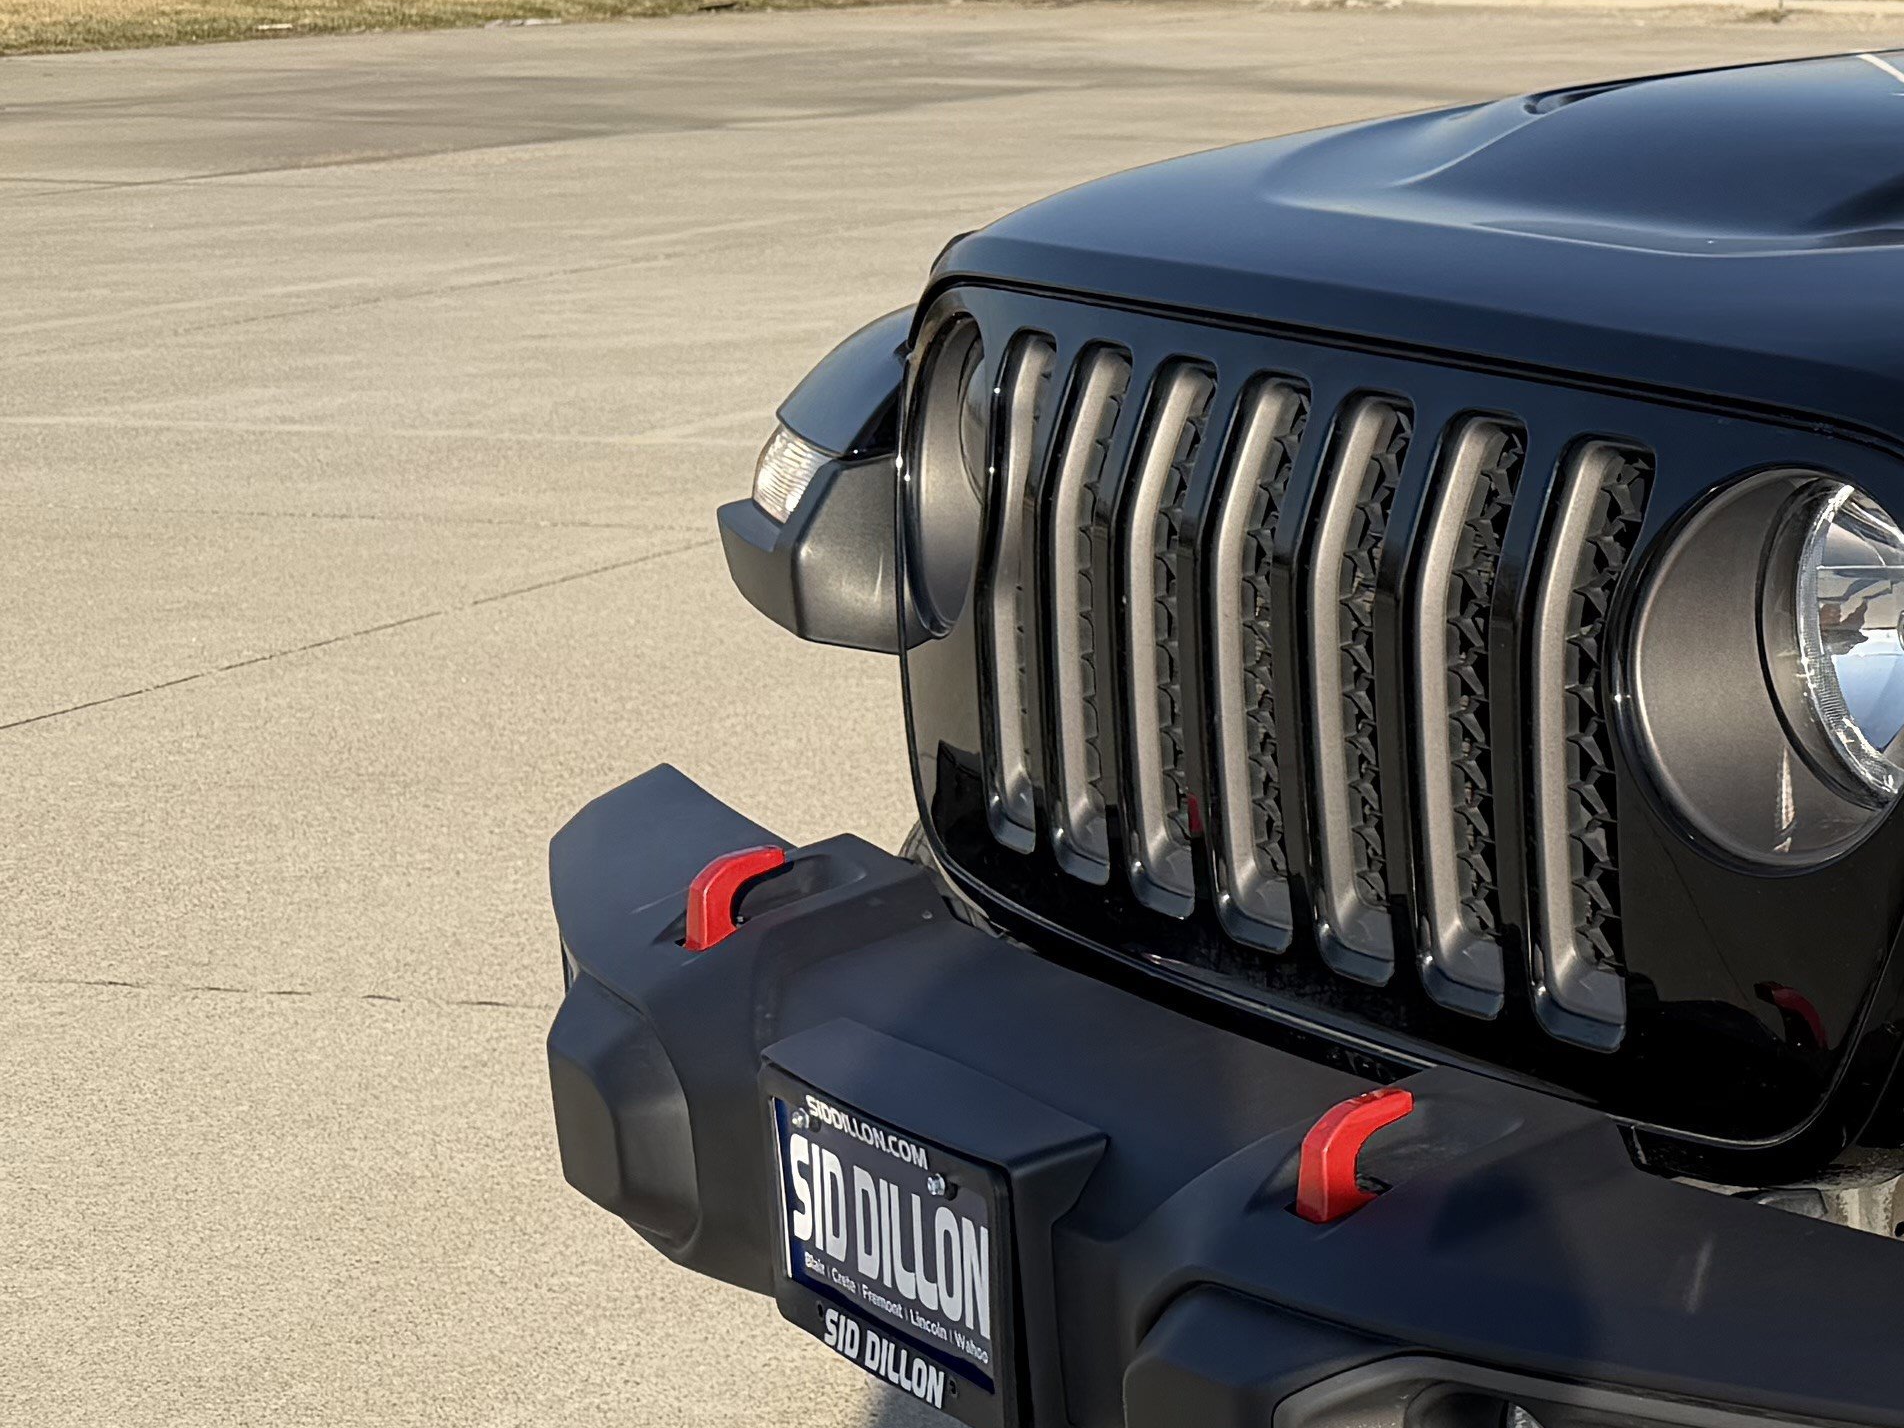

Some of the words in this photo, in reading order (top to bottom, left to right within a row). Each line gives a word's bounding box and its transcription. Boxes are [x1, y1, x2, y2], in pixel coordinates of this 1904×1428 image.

[805, 1094, 929, 1170] SIDDILLON.COM
[790, 1133, 847, 1263] SID
[853, 1164, 991, 1340] DILLON
[824, 1307, 861, 1360] SID
[864, 1328, 945, 1410] DILLON
[861, 1283, 904, 1320] Fremont
[909, 1308, 948, 1342] Lincoln
[954, 1329, 990, 1365] Wahoo
